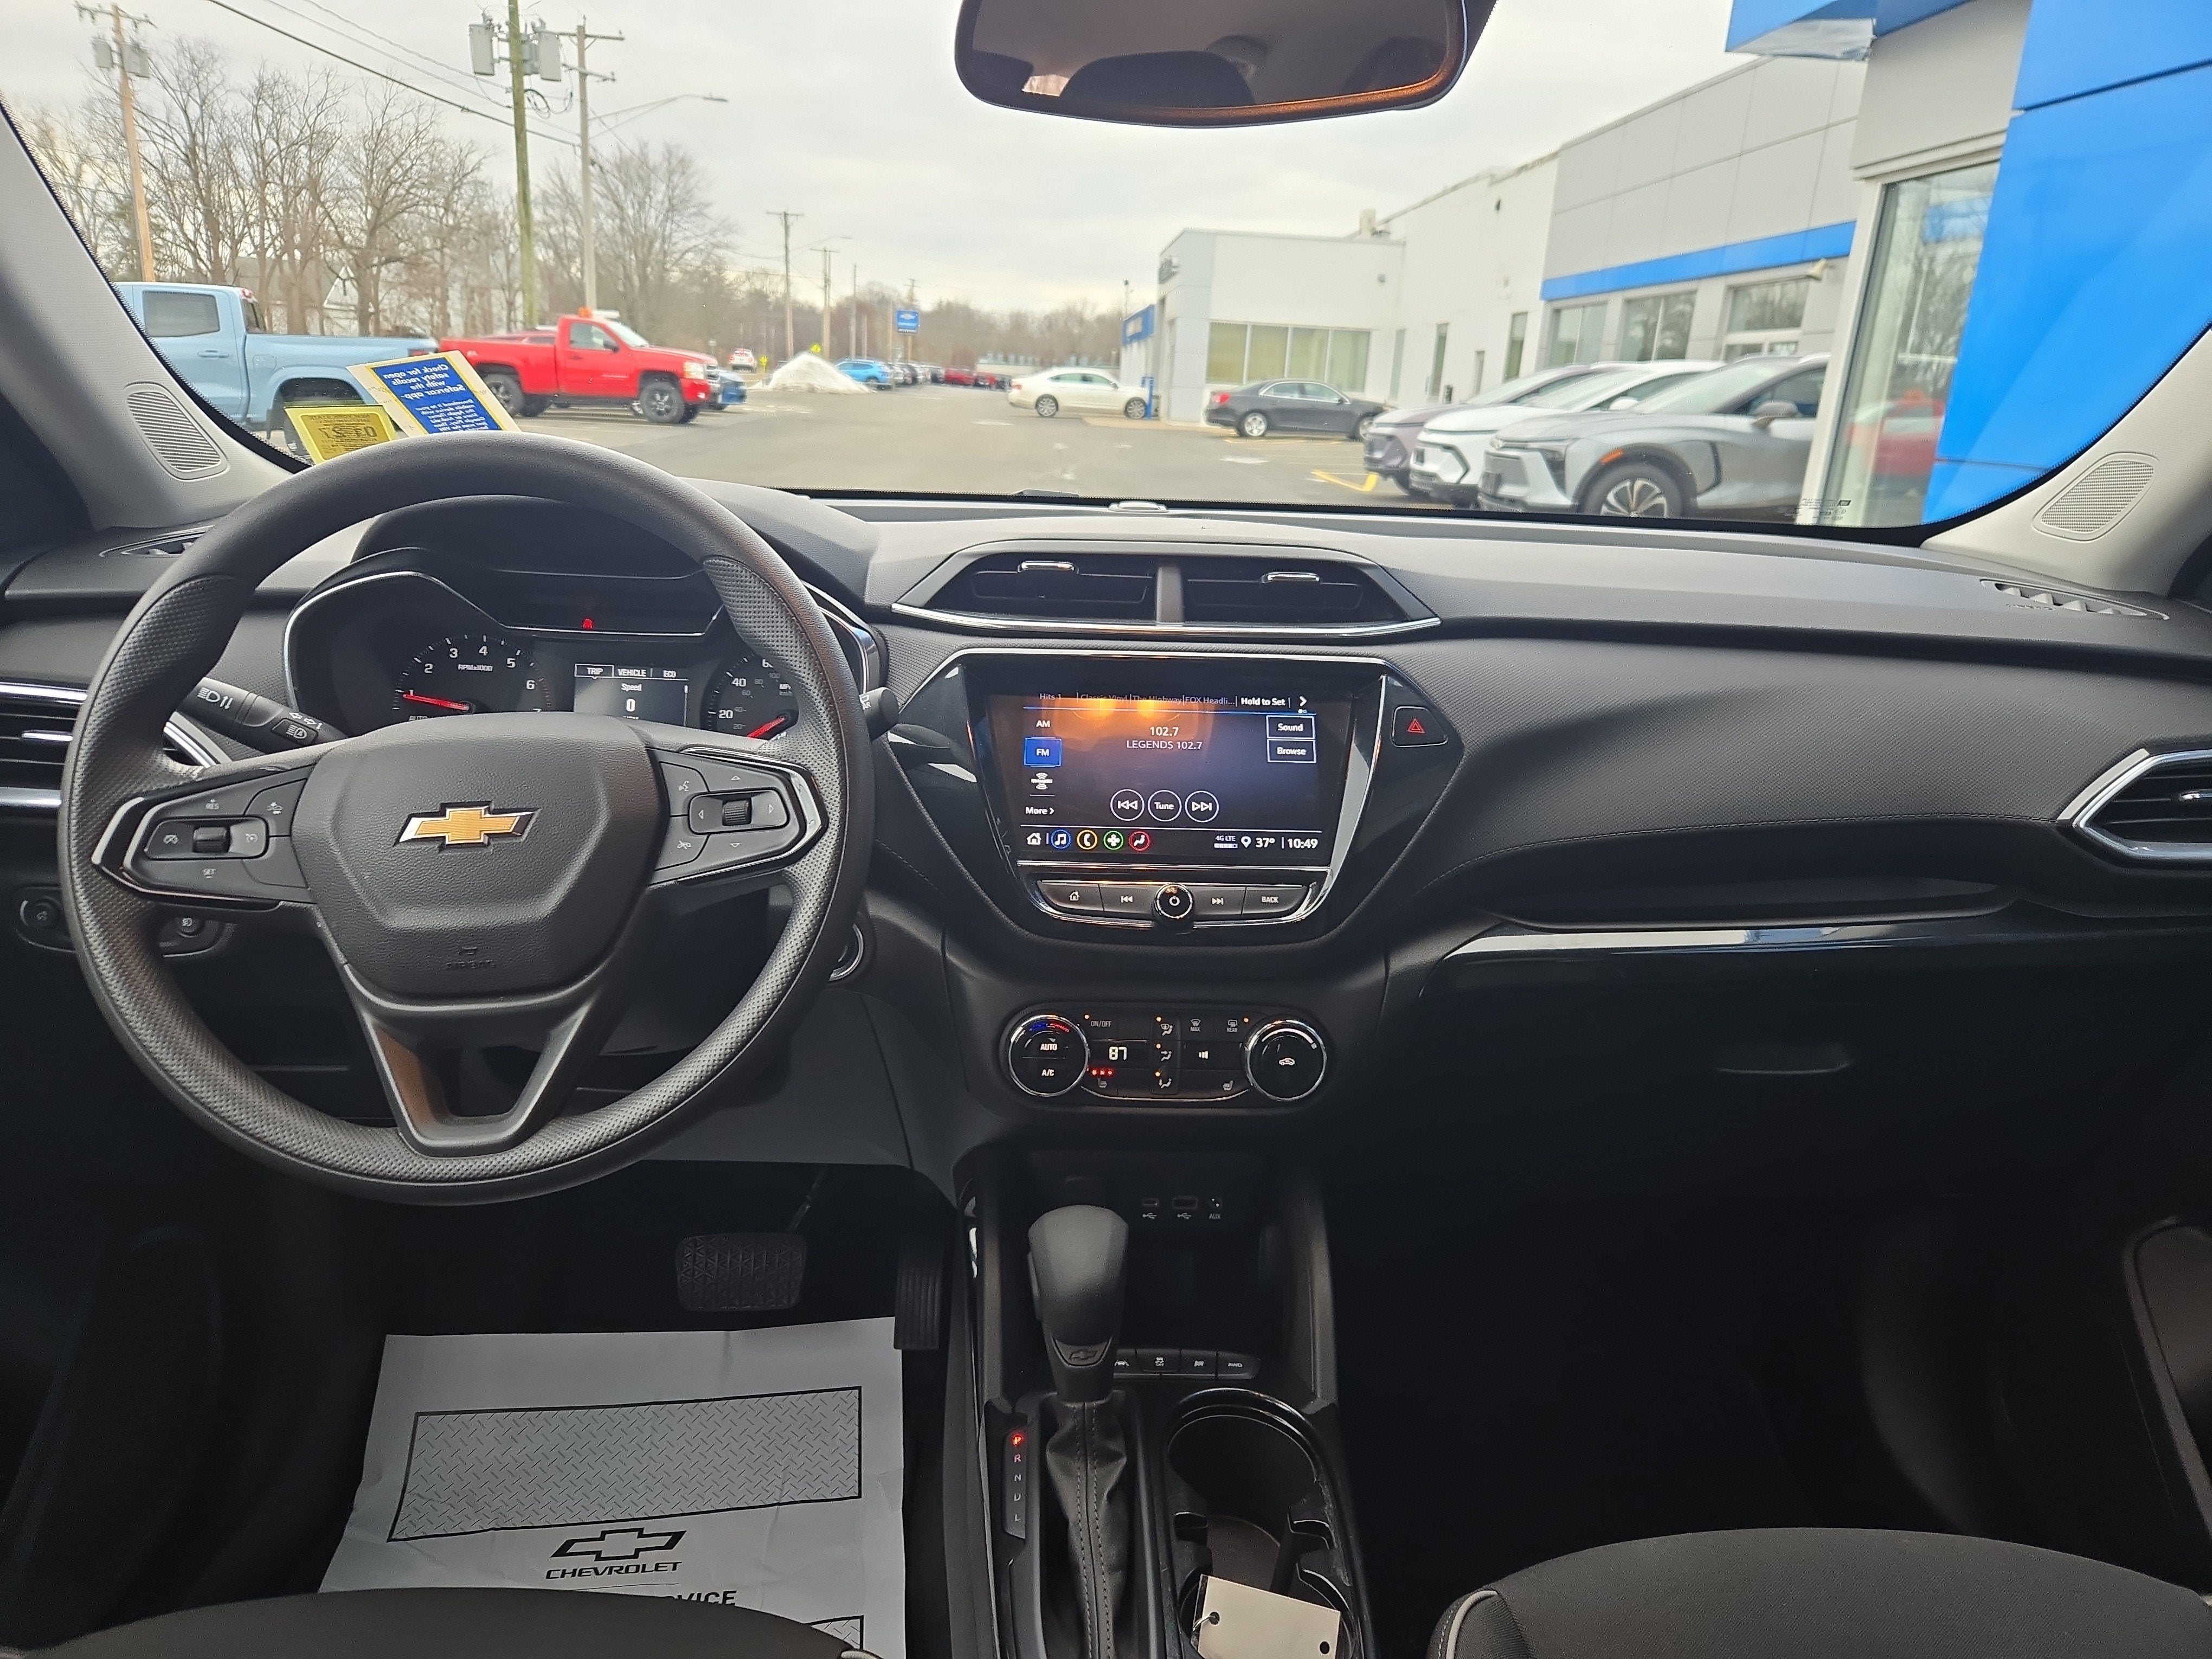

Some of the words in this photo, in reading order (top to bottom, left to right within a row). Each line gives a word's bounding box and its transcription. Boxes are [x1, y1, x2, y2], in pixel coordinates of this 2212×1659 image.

[449, 648, 458, 658] 3
[479, 646, 488, 656] 4
[507, 658, 516, 668] 5
[762, 659, 774, 668] 6
[424, 663, 433, 673] 2
[618, 668, 647, 677] VEHICLE
[526, 680, 535, 690] 6
[621, 683, 642, 691] Speed
[732, 678, 747, 687] 40
[626, 698, 635, 712] 0
[1149, 696, 1182, 705] Highway
[718, 710, 734, 719] 20
[1150, 726, 1179, 736] 102.7
[1277, 723, 1304, 731] Sound
[1126, 740, 1174, 749] LEGENDS
[1176, 741, 1203, 750] 102.7
[1277, 747, 1307, 755] Browse
[1287, 838, 1319, 849] 10:49
[1109, 1046, 1127, 1060] 87
[1013, 1436, 1022, 1445] P
[1014, 1454, 1021, 1463] R
[1014, 1474, 1021, 1482] N
[545, 1561, 683, 1579] CHEVROLET
